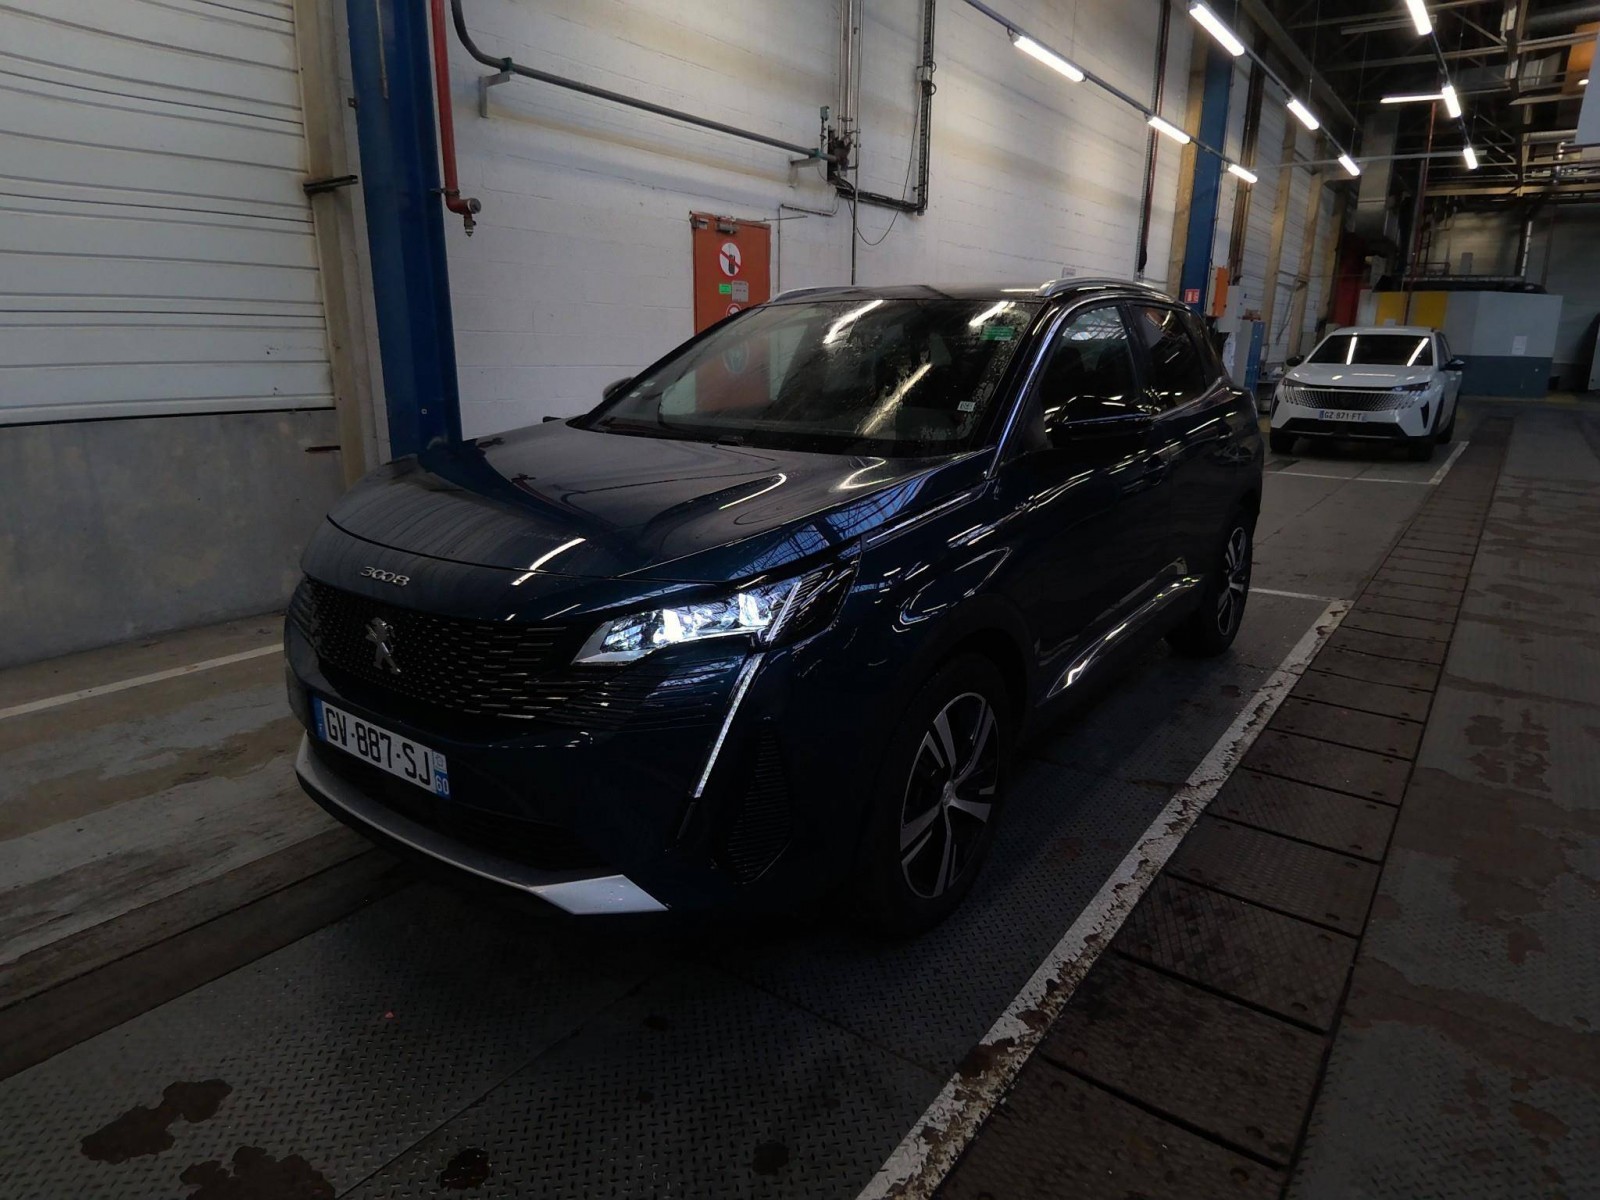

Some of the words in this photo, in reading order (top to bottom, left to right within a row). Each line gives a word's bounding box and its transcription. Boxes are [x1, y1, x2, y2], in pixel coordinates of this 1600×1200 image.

[360, 566, 411, 587] 3008
[325, 707, 431, 786] GV-887-SJ
[435, 775, 449, 796] 60
